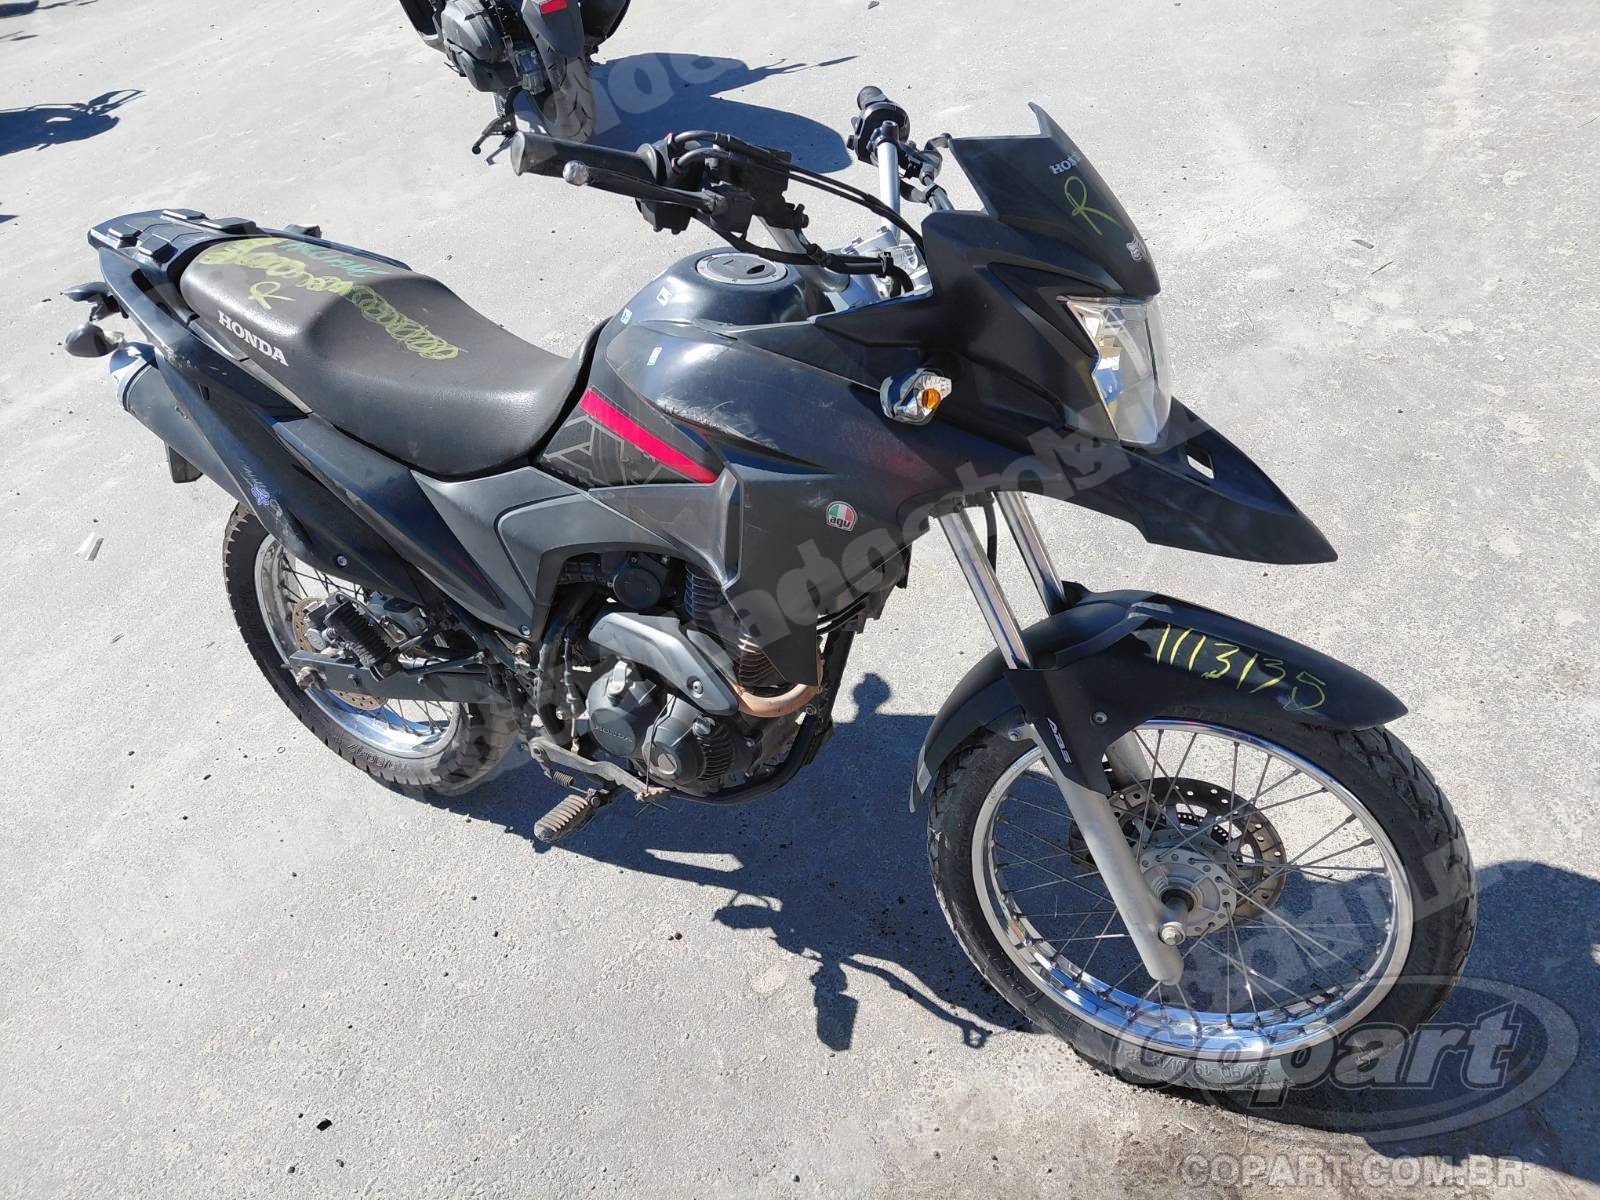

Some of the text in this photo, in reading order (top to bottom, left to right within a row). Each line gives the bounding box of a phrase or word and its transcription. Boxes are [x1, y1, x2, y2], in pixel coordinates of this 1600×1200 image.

[1050, 154, 1080, 174] HON
[217, 310, 289, 367] HONDA
[593, 725, 633, 743] HONDA
